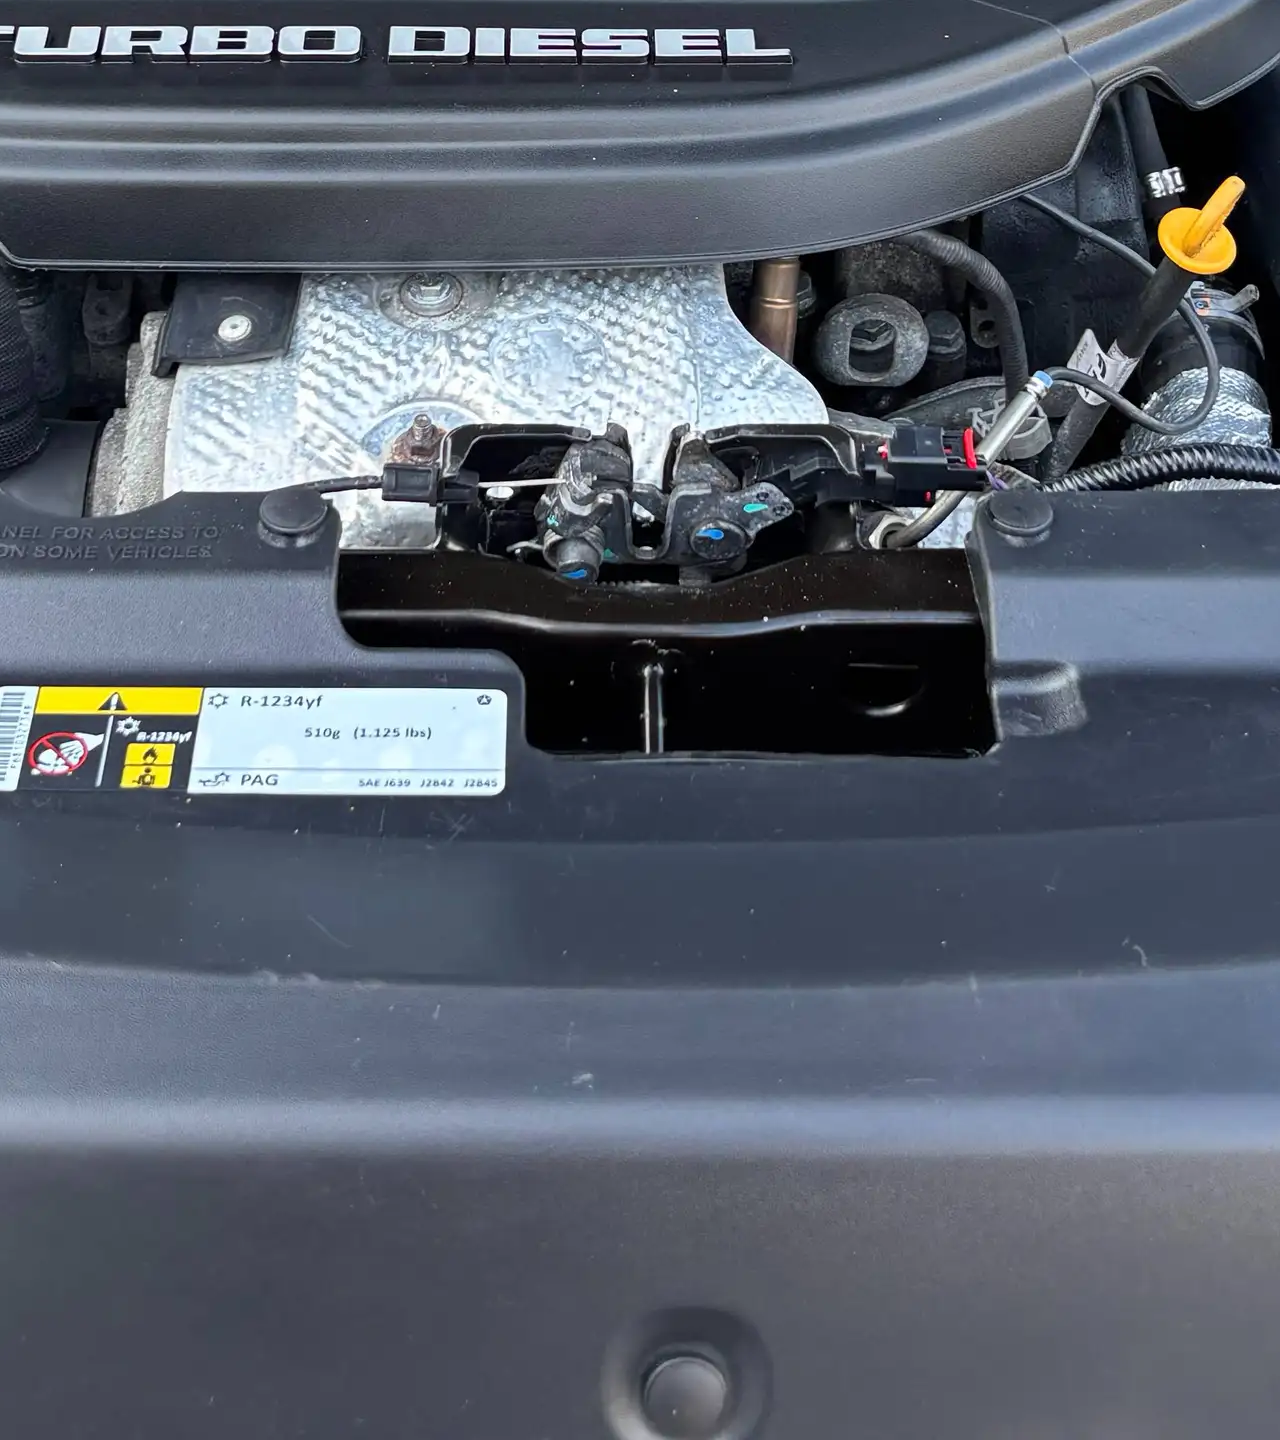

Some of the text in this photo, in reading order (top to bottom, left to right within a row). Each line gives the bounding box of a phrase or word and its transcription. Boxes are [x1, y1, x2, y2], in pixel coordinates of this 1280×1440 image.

[387, 26, 796, 65] DIESEL
[51, 526, 94, 539] FOR
[99, 526, 184, 539] ACCESS
[193, 526, 219, 539] TO
[33, 545, 99, 558] SOME
[107, 545, 213, 559] VEHICLES
[240, 694, 324, 708] R-1234yf
[304, 726, 432, 740] 510g (1.125 lbs)
[240, 774, 279, 786] PAG
[359, 779, 381, 787] SAE
[383, 779, 411, 787] J639
